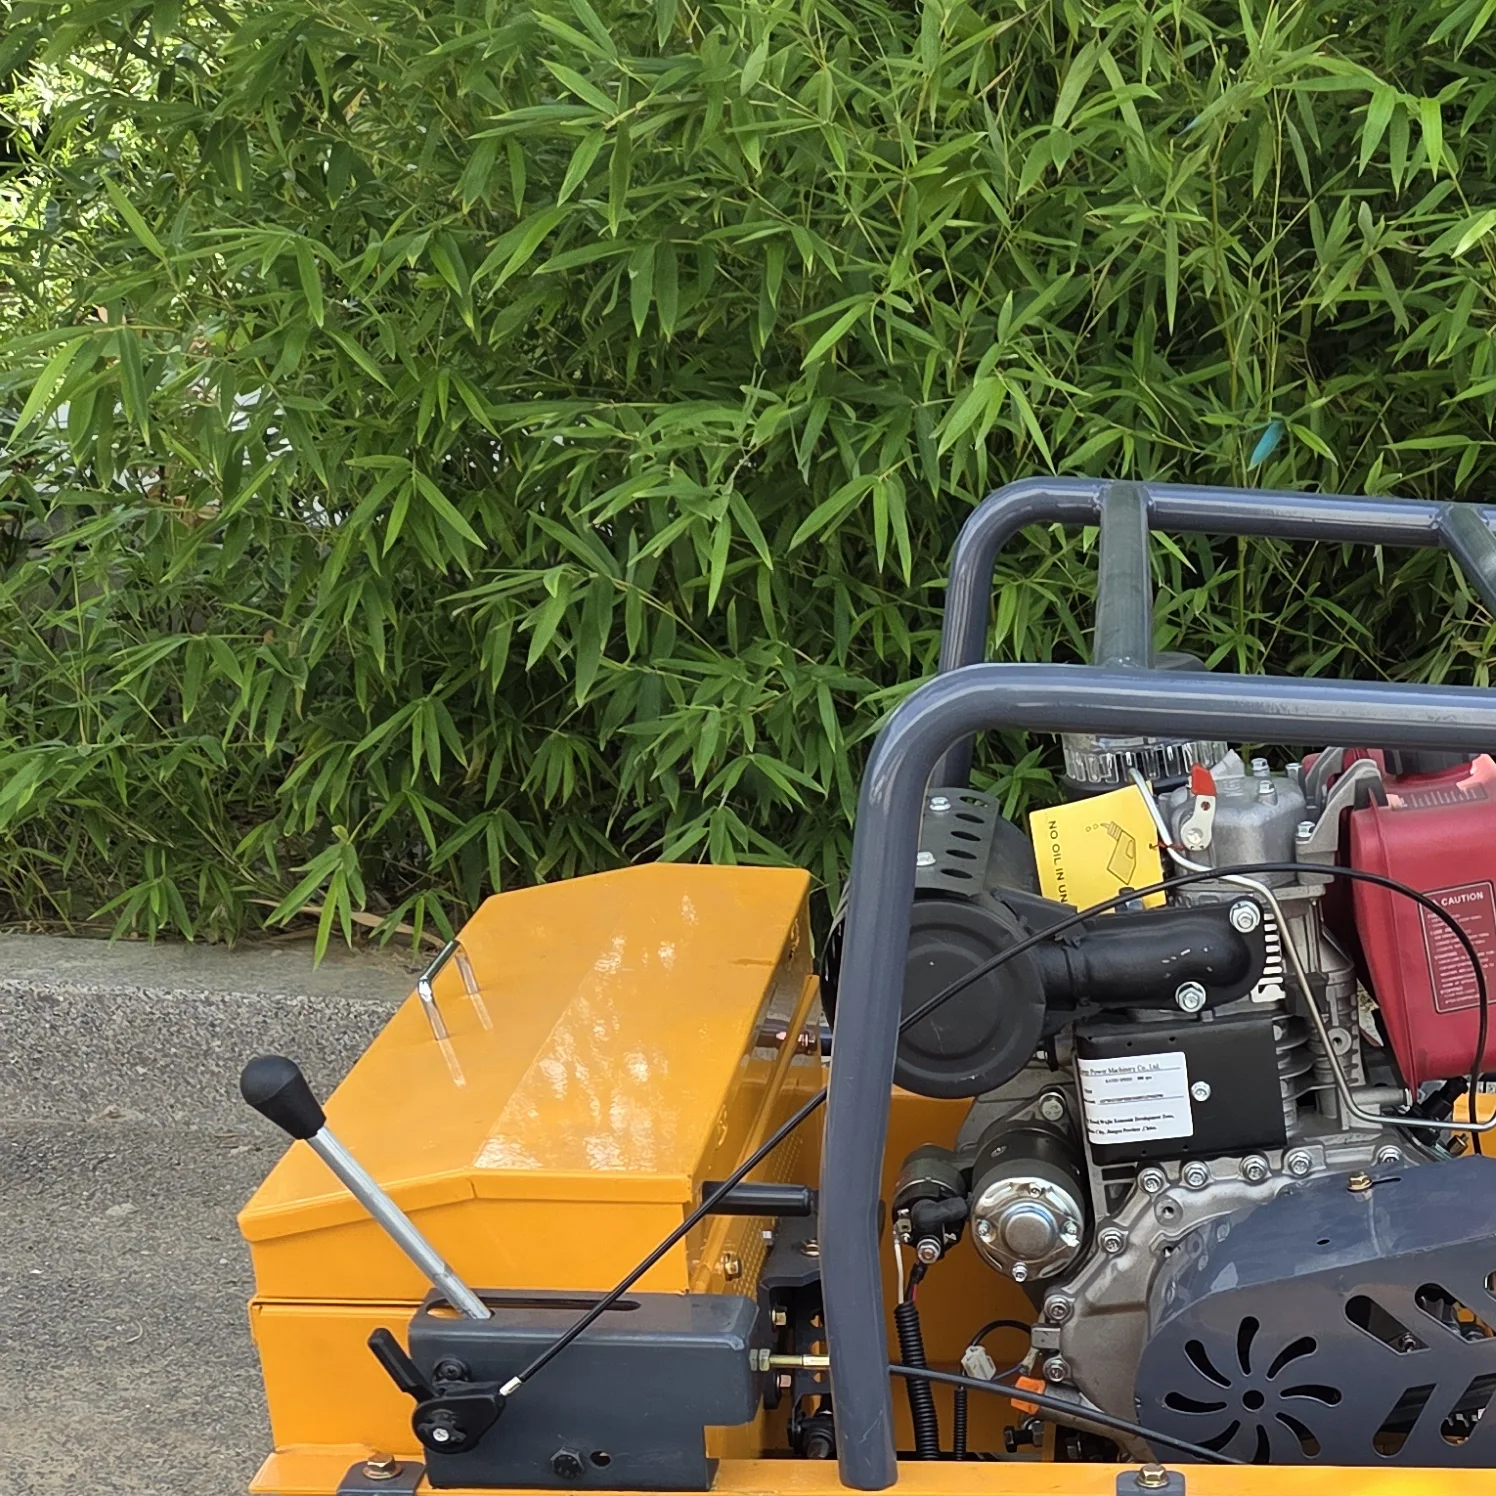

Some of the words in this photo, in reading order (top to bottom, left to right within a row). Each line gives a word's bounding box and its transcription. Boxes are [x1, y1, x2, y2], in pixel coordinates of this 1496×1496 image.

[1048, 820, 1059, 839] NO
[1052, 843, 1061, 866] OIL
[1055, 868, 1065, 881] IN
[1440, 891, 1484, 907] CAUTION
